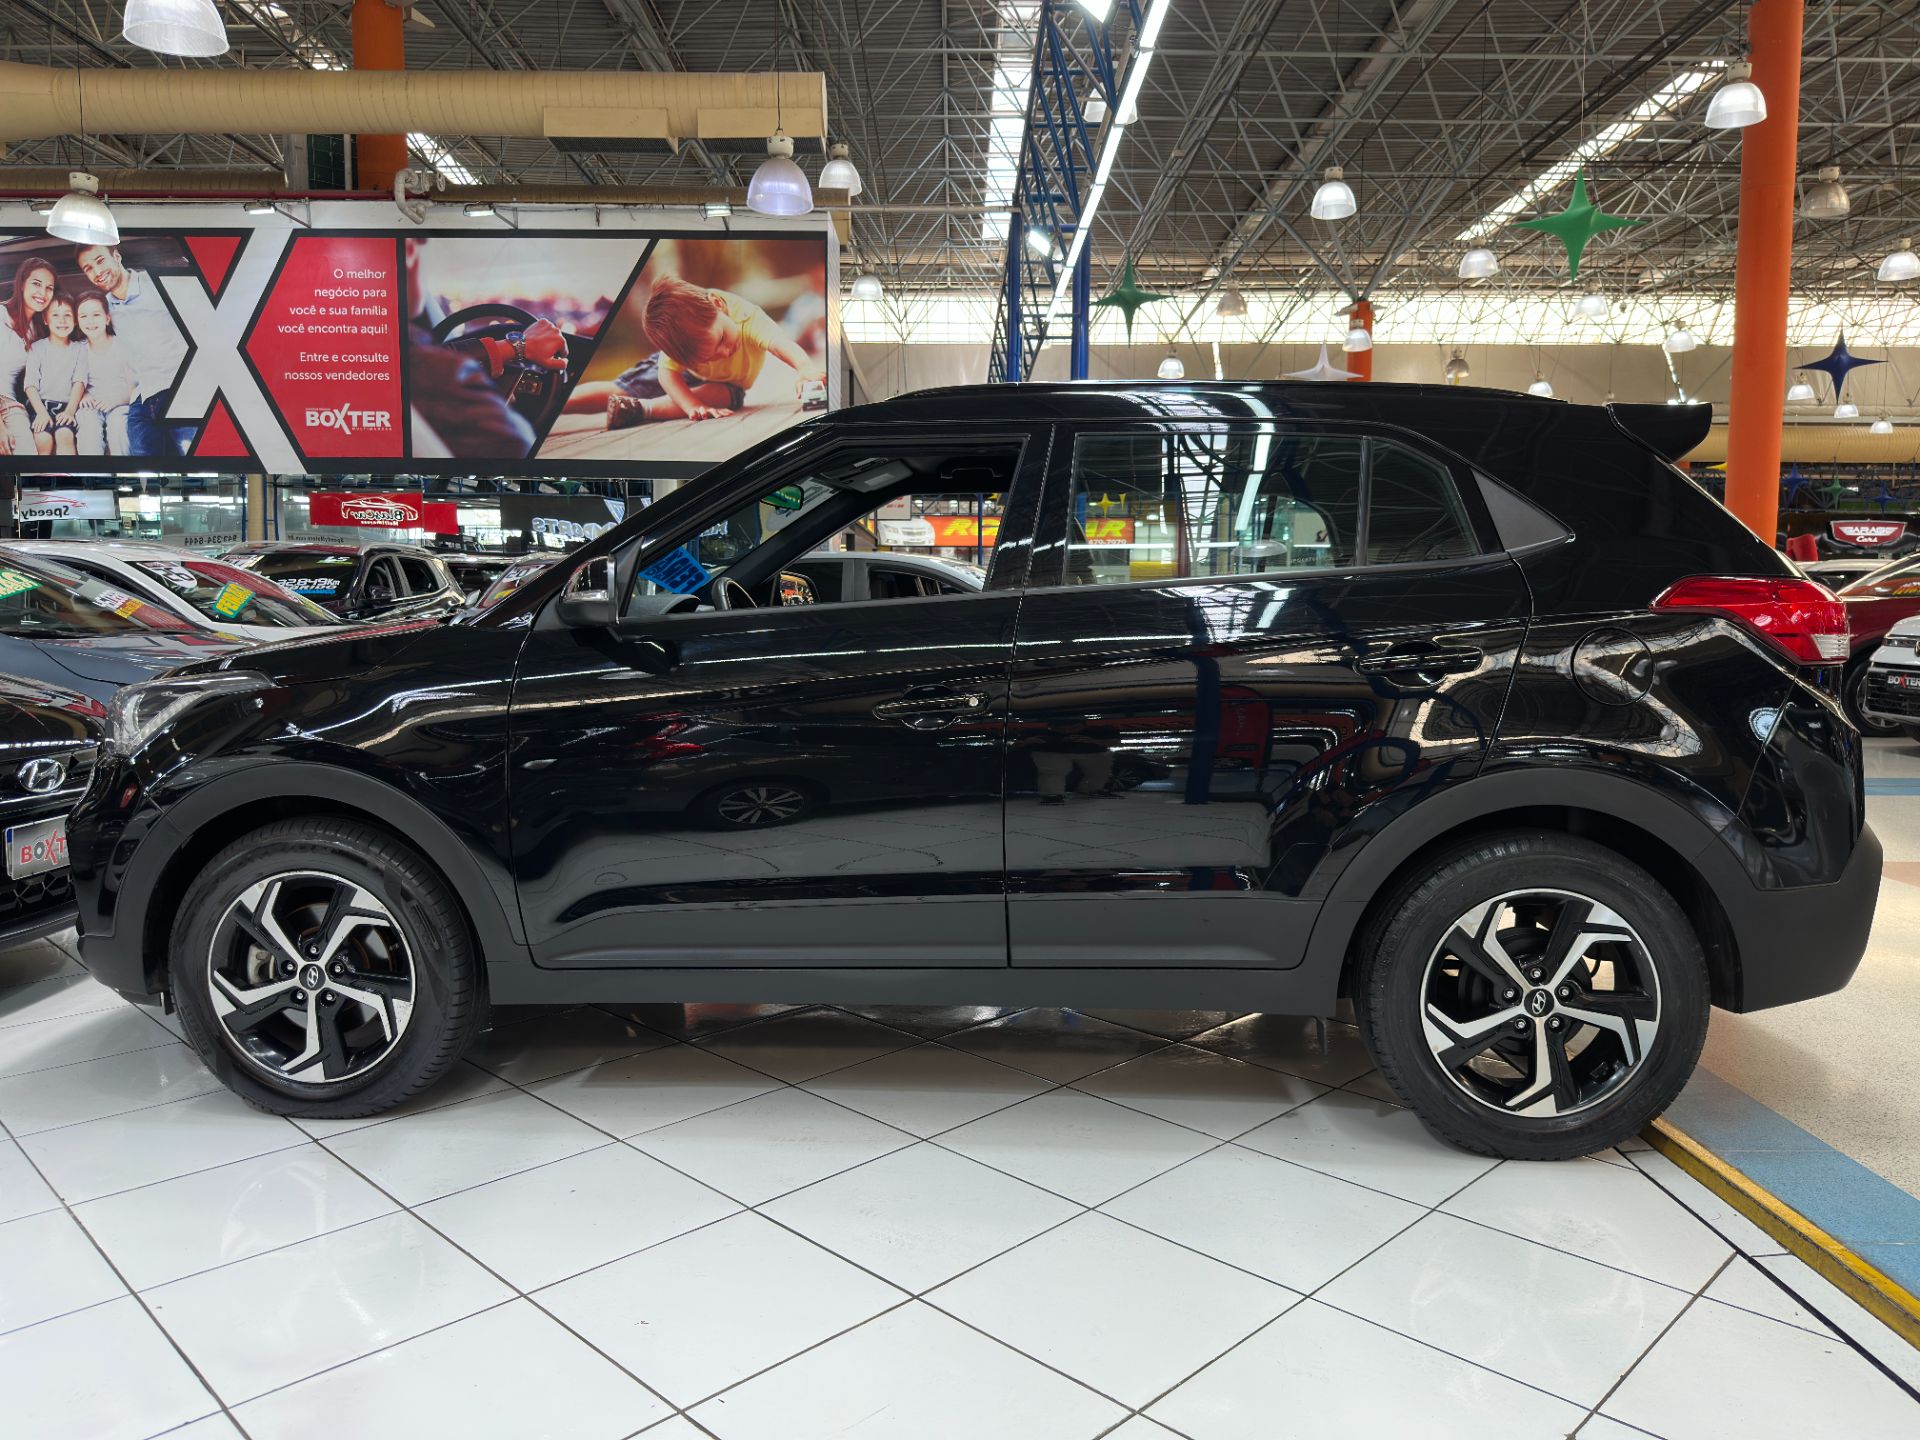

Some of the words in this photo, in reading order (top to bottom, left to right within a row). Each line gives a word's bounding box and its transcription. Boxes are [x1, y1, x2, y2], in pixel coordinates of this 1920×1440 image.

[333, 268, 344, 279] O
[346, 268, 386, 279] melhor
[314, 286, 360, 299] negócio
[362, 289, 387, 299] para
[289, 305, 316, 315] você
[319, 307, 326, 315] e
[329, 307, 348, 315] sua
[350, 305, 388, 316] família
[278, 323, 305, 334] você
[307, 324, 358, 334] encontra
[360, 323, 388, 336] aqui!
[300, 351, 329, 362] Entre
[332, 354, 339, 362] e
[341, 352, 389, 363] consulte
[284, 372, 323, 380] nossos
[325, 370, 390, 381] vendedores
[305, 403, 391, 435] BOXTER
